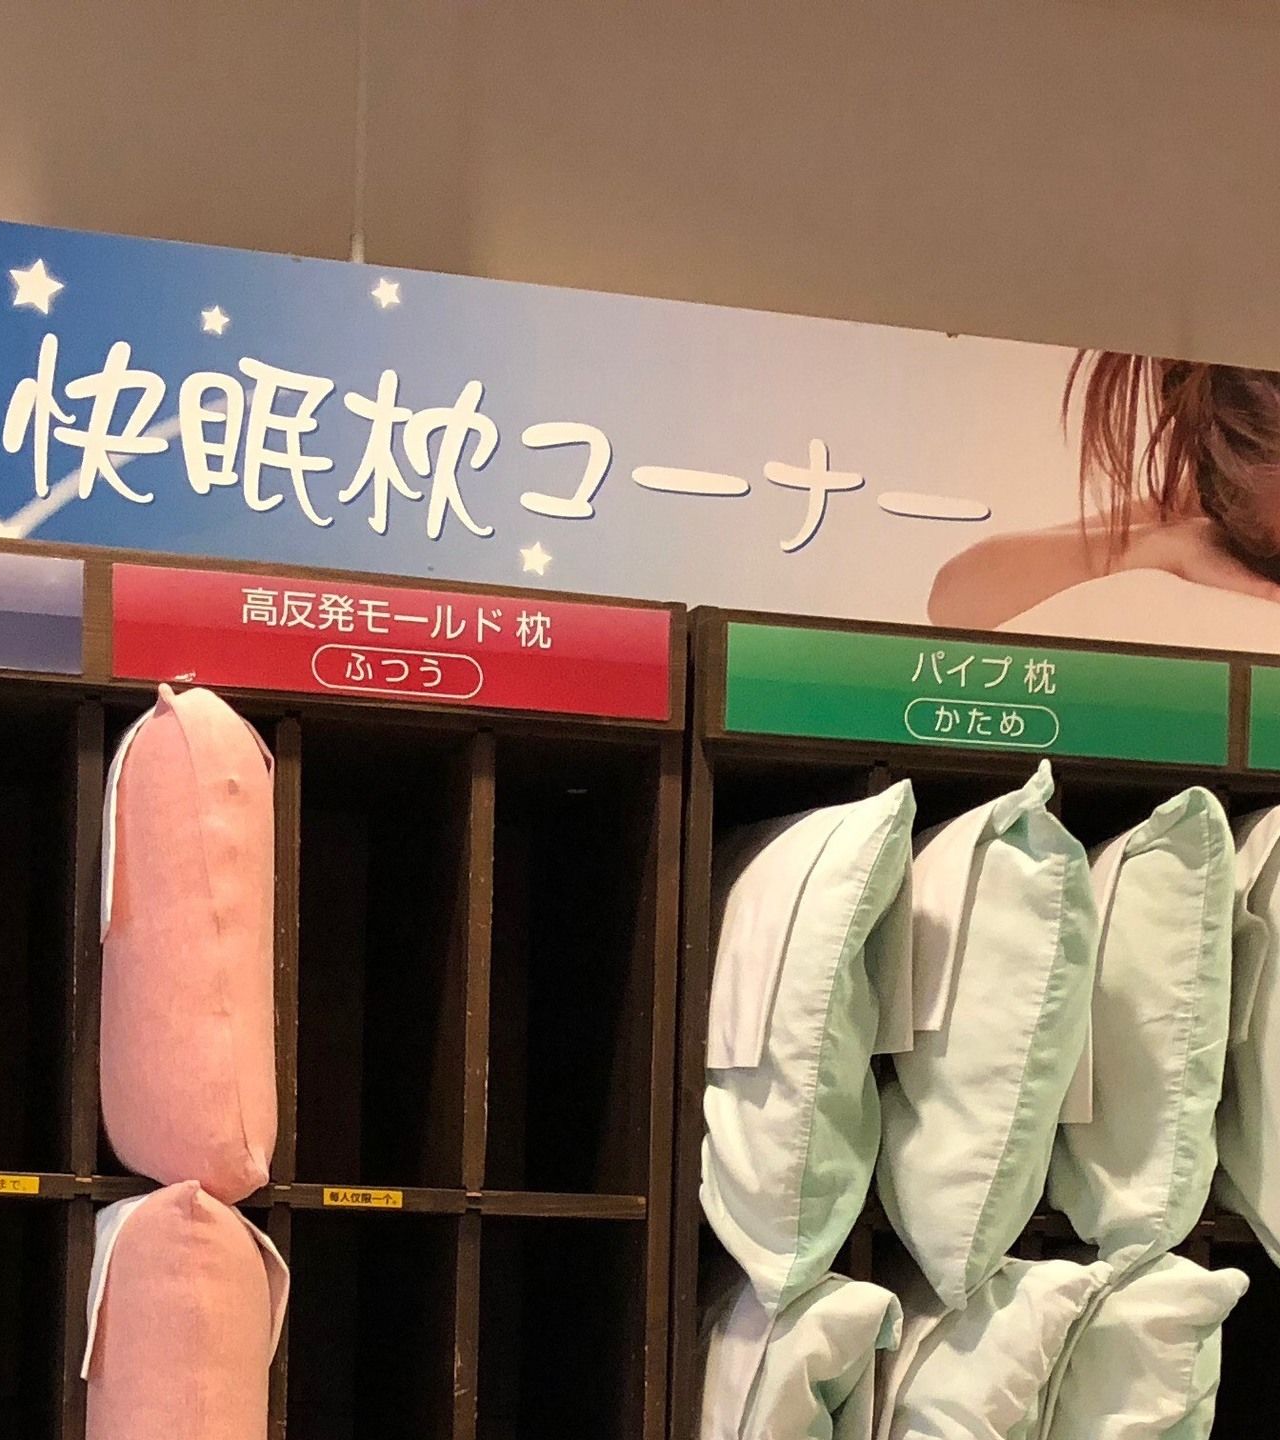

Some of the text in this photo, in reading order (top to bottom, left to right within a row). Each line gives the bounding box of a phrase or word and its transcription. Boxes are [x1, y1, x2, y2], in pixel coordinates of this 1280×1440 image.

[2, 331, 991, 554] 快眠枕コーナー
[345, 653, 444, 688] ふつう
[935, 705, 1025, 737] かため
